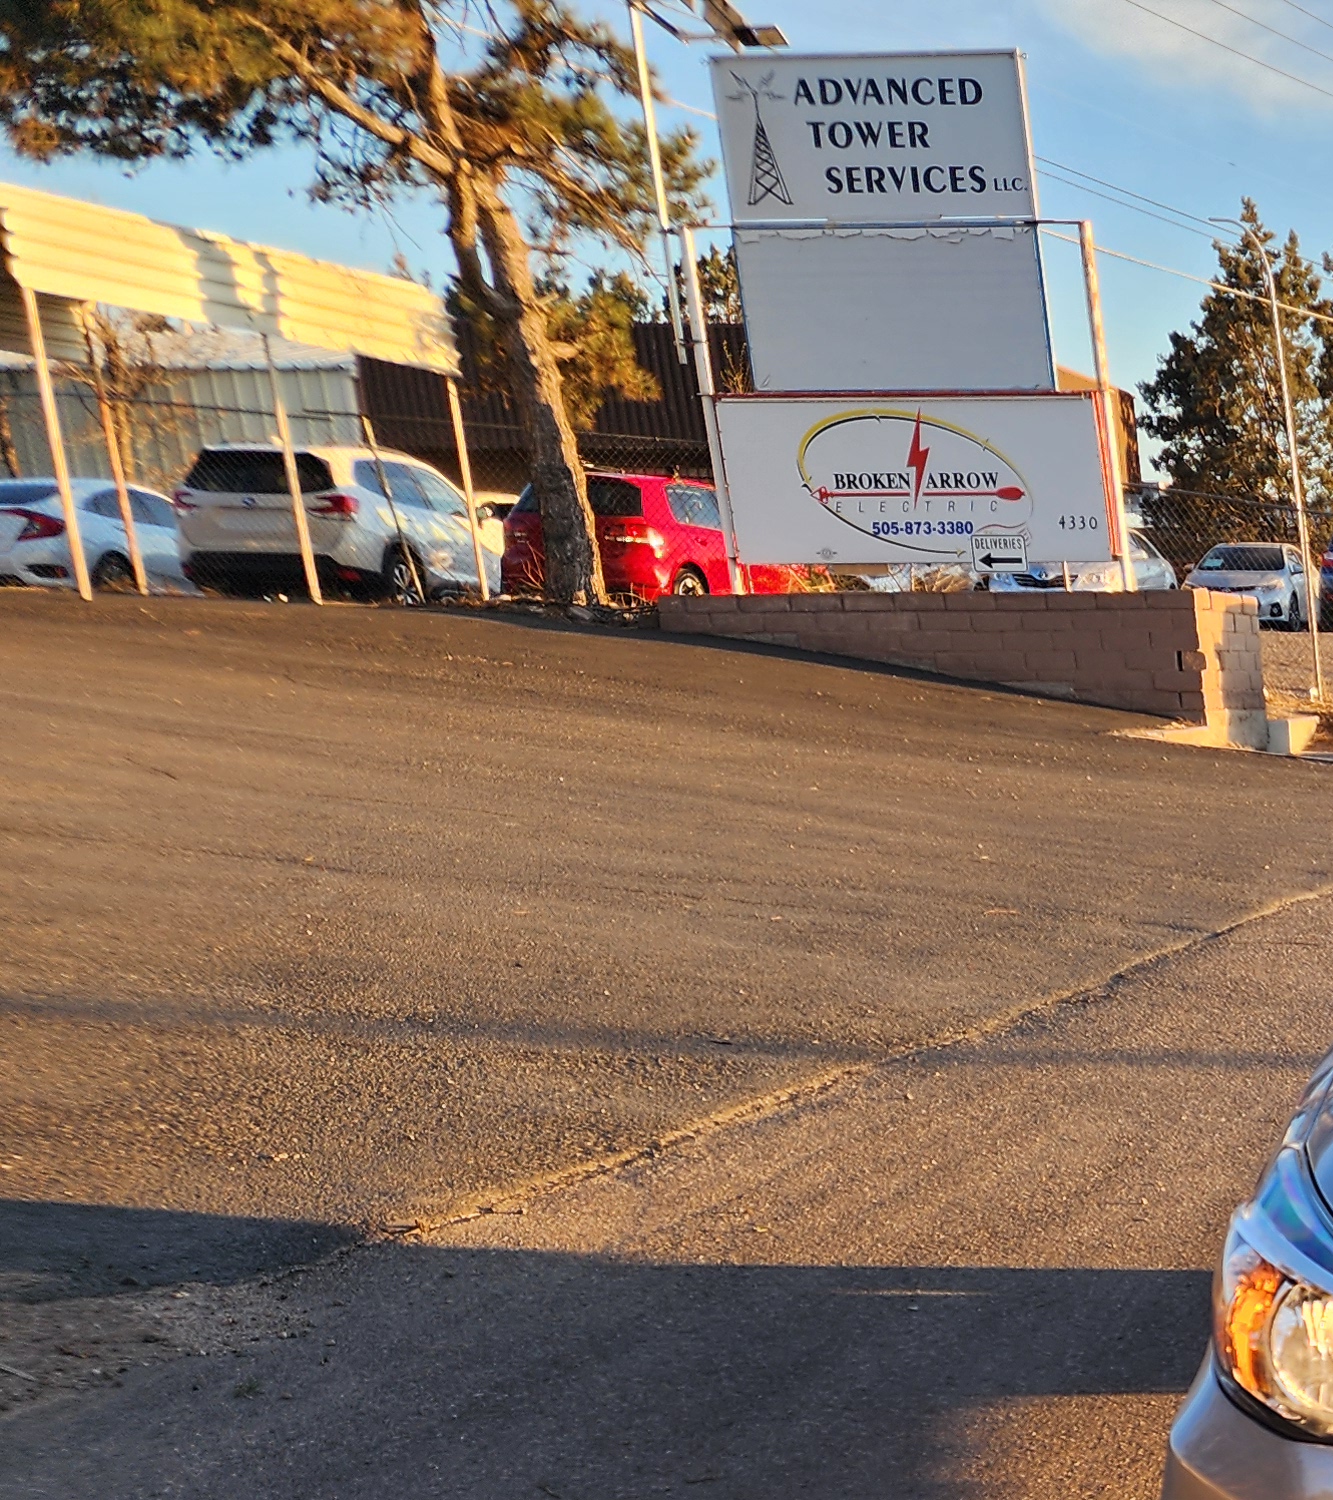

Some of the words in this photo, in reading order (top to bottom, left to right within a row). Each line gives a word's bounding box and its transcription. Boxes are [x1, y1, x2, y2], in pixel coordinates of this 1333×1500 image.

[794, 78, 983, 106] ADVANCED
[806, 120, 931, 149] TOWER
[825, 165, 986, 194] SERVICES
[833, 472, 911, 490] BROKEN
[926, 471, 999, 489] ARROW
[836, 500, 999, 513] ELECTRIC
[871, 521, 974, 536] 505-873-3380
[1058, 515, 1098, 531] 4330
[974, 536, 1023, 550] DELIVERIES
